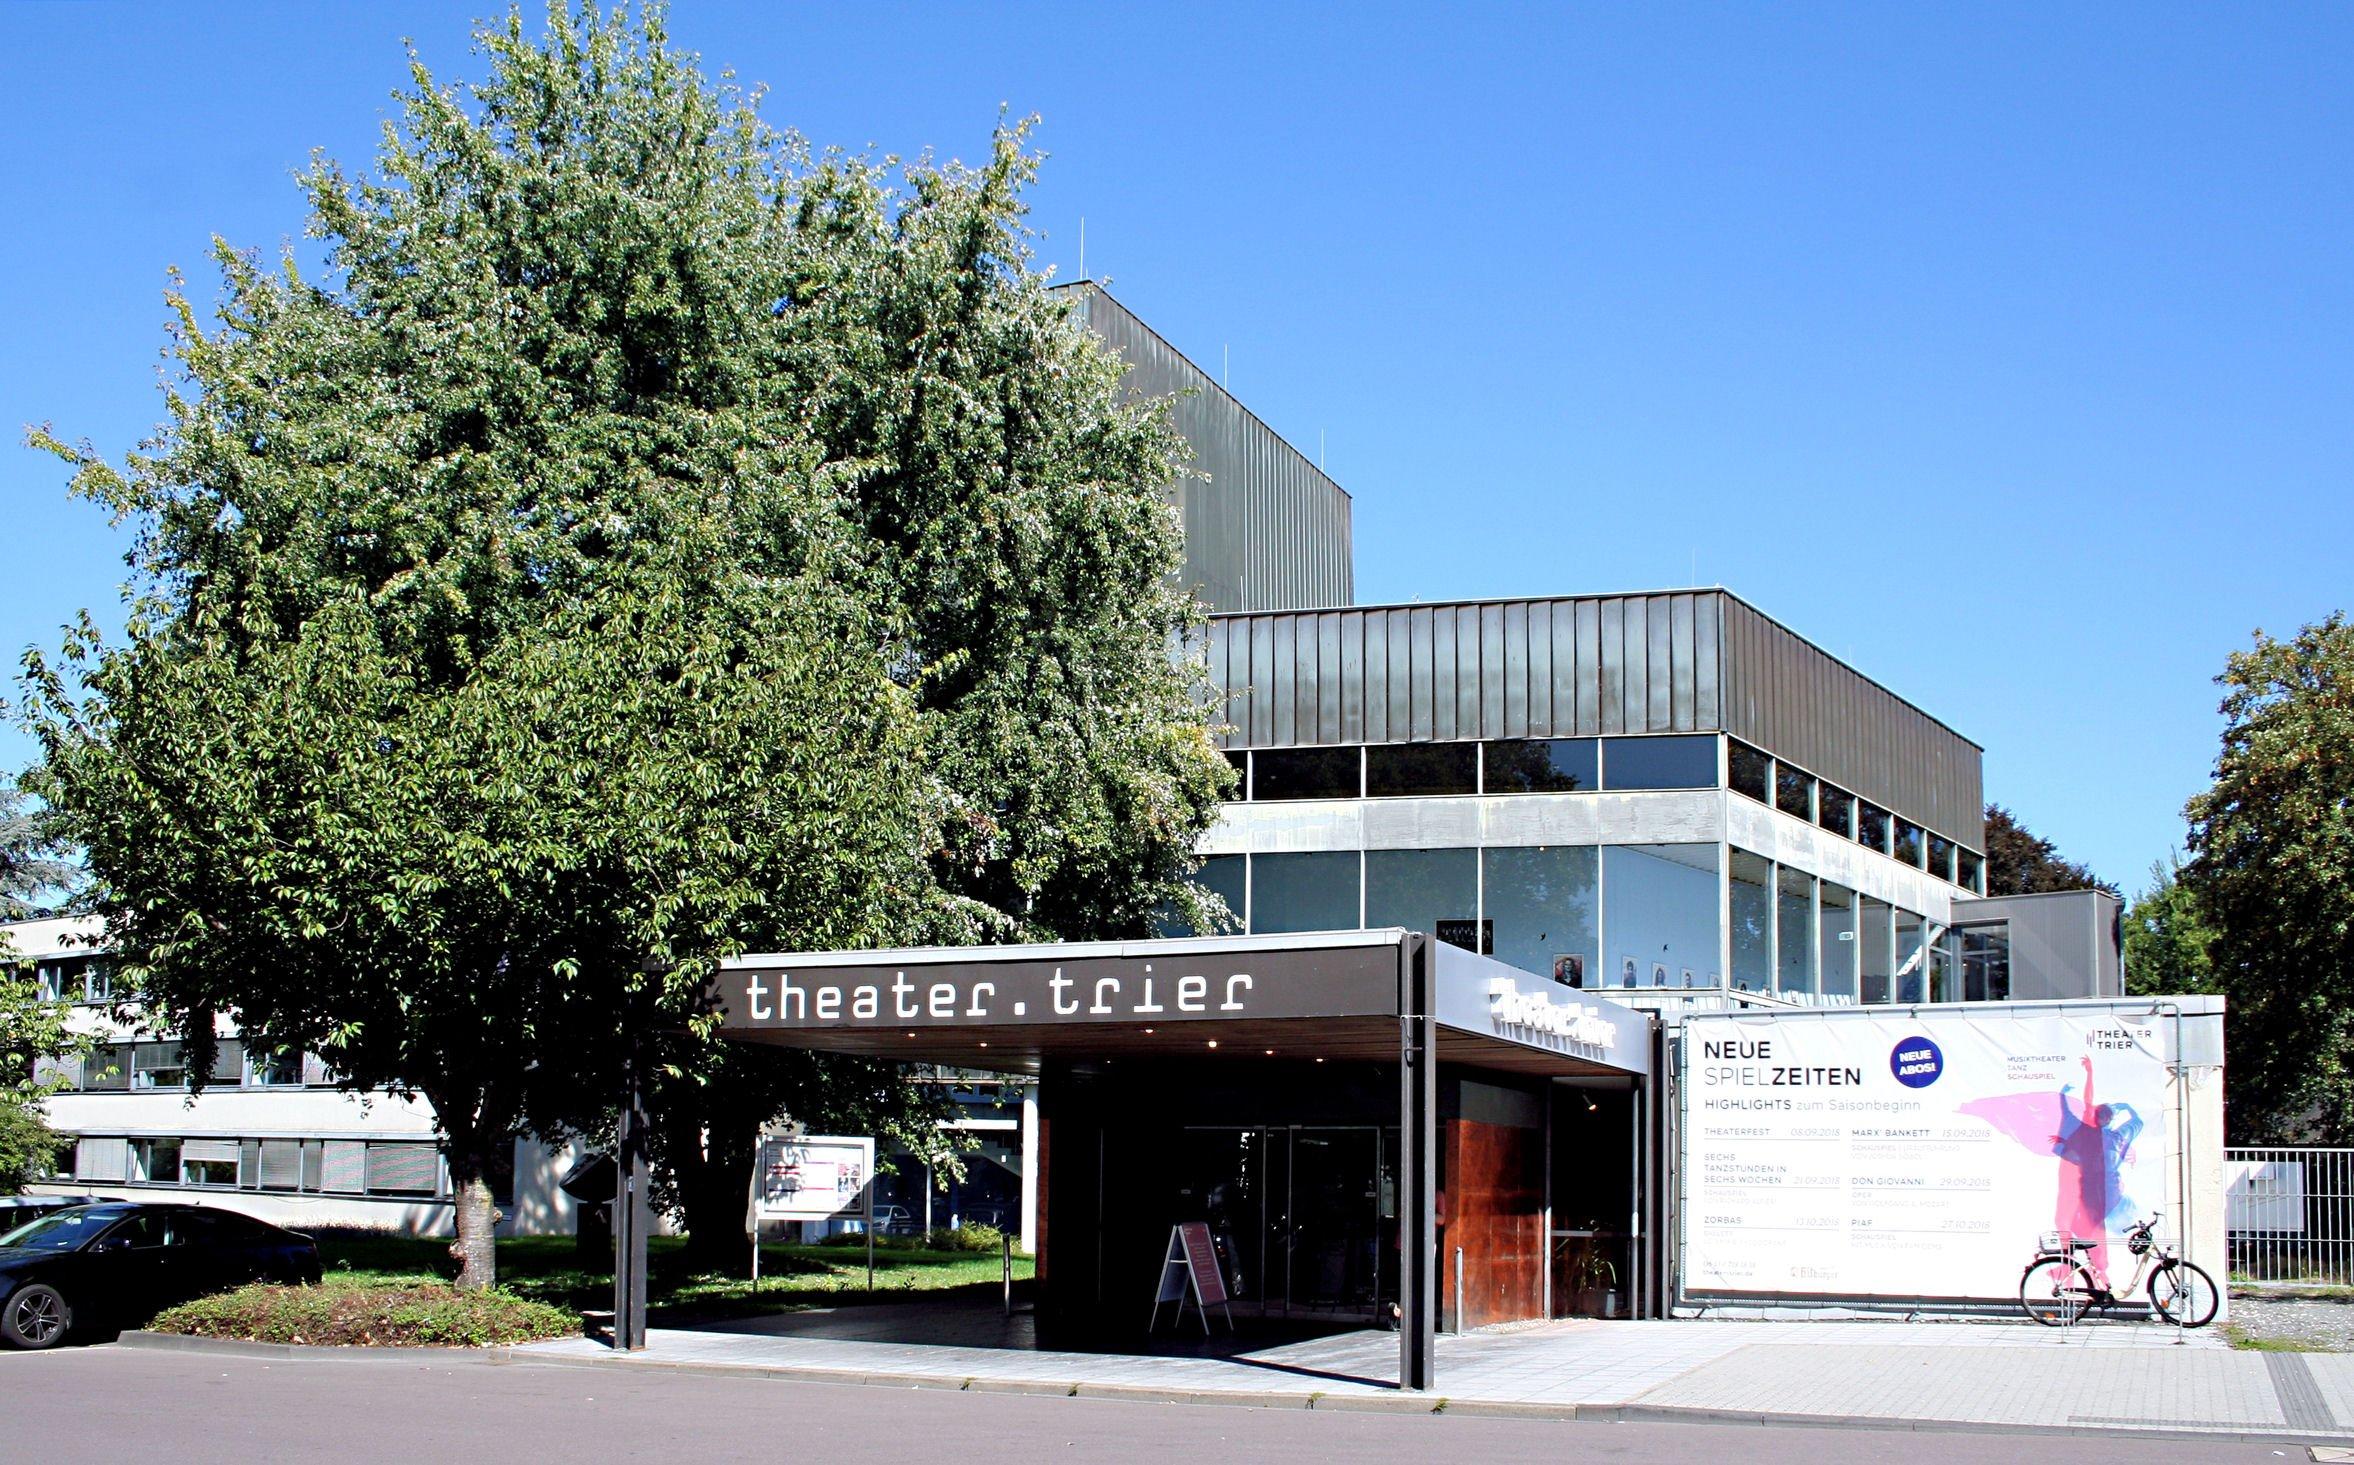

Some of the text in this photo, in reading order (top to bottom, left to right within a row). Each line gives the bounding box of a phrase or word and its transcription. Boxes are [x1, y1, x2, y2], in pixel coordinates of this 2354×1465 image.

[746, 966, 1253, 1020] theater.trier
[2097, 1041, 2133, 1049] TRIER
[1704, 1041, 1772, 1059] NEUE
[1900, 1050, 1931, 1062] NEUE
[1899, 1062, 1936, 1076] ABOS!
[1704, 1067, 1861, 1086] SPIELZEITEN
[1705, 1099, 1921, 1113] HIGHLIGHTS zum Saisonbeginn
[1704, 1127, 1771, 1136] THEATERFEST
[1885, 1129, 1930, 1137] BANKETT
[1704, 1153, 1736, 1161] SECHS
[1704, 1164, 1787, 1173] TANZSTUNDEN IN
[1704, 1175, 1782, 1184] SECHS WOCHEN
[1852, 1177, 1924, 1185] DON GIOVANNI
[1704, 1216, 1742, 1224] ZORBAS
[1851, 1219, 1873, 1227] PIAF
